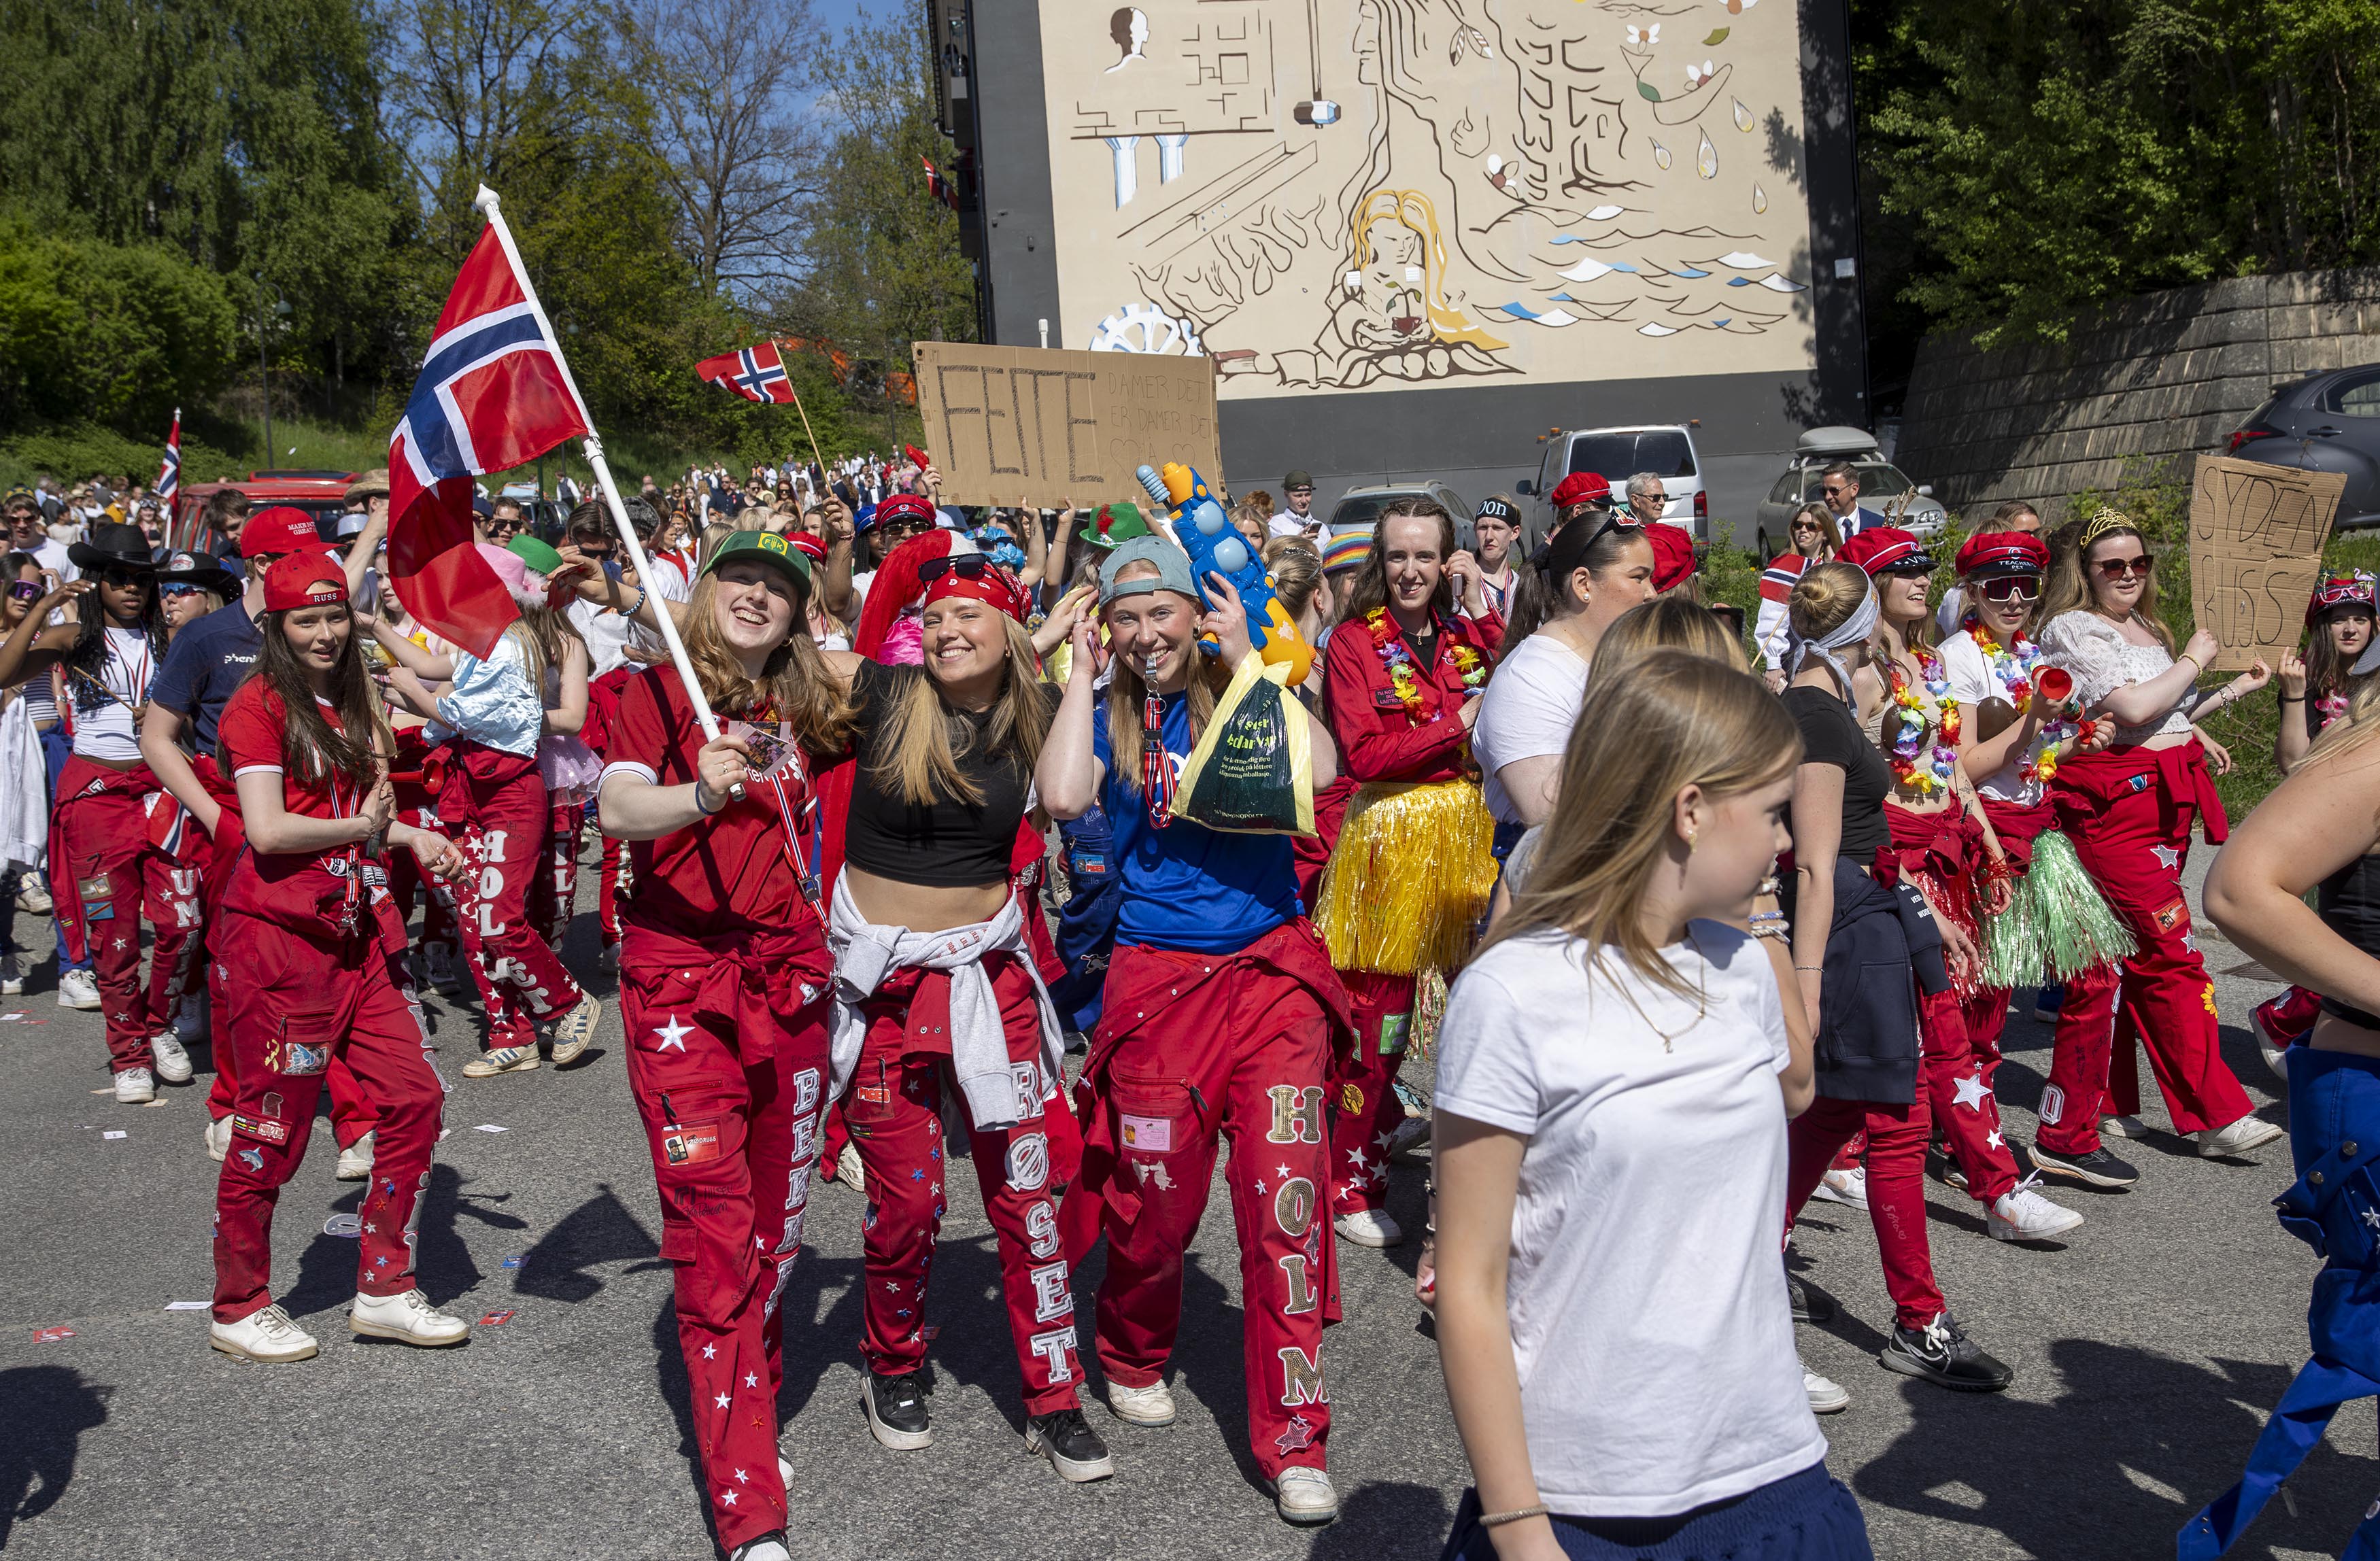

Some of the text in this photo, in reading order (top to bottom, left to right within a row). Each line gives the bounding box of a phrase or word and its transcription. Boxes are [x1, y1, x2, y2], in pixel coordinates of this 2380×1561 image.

[936, 365, 1104, 483] FEITE
[1108, 372, 1206, 402] DAMER DET
[1111, 406, 1212, 439] ER DAMER DET
[288, 521, 307, 530] MAKE
[2197, 466, 2335, 554] SYDEN
[314, 593, 337, 602] RUSS
[2201, 555, 2289, 651] RUSS
[1005, 1060, 1078, 1384] RØSET
[1265, 1084, 1331, 1407] HOLM
